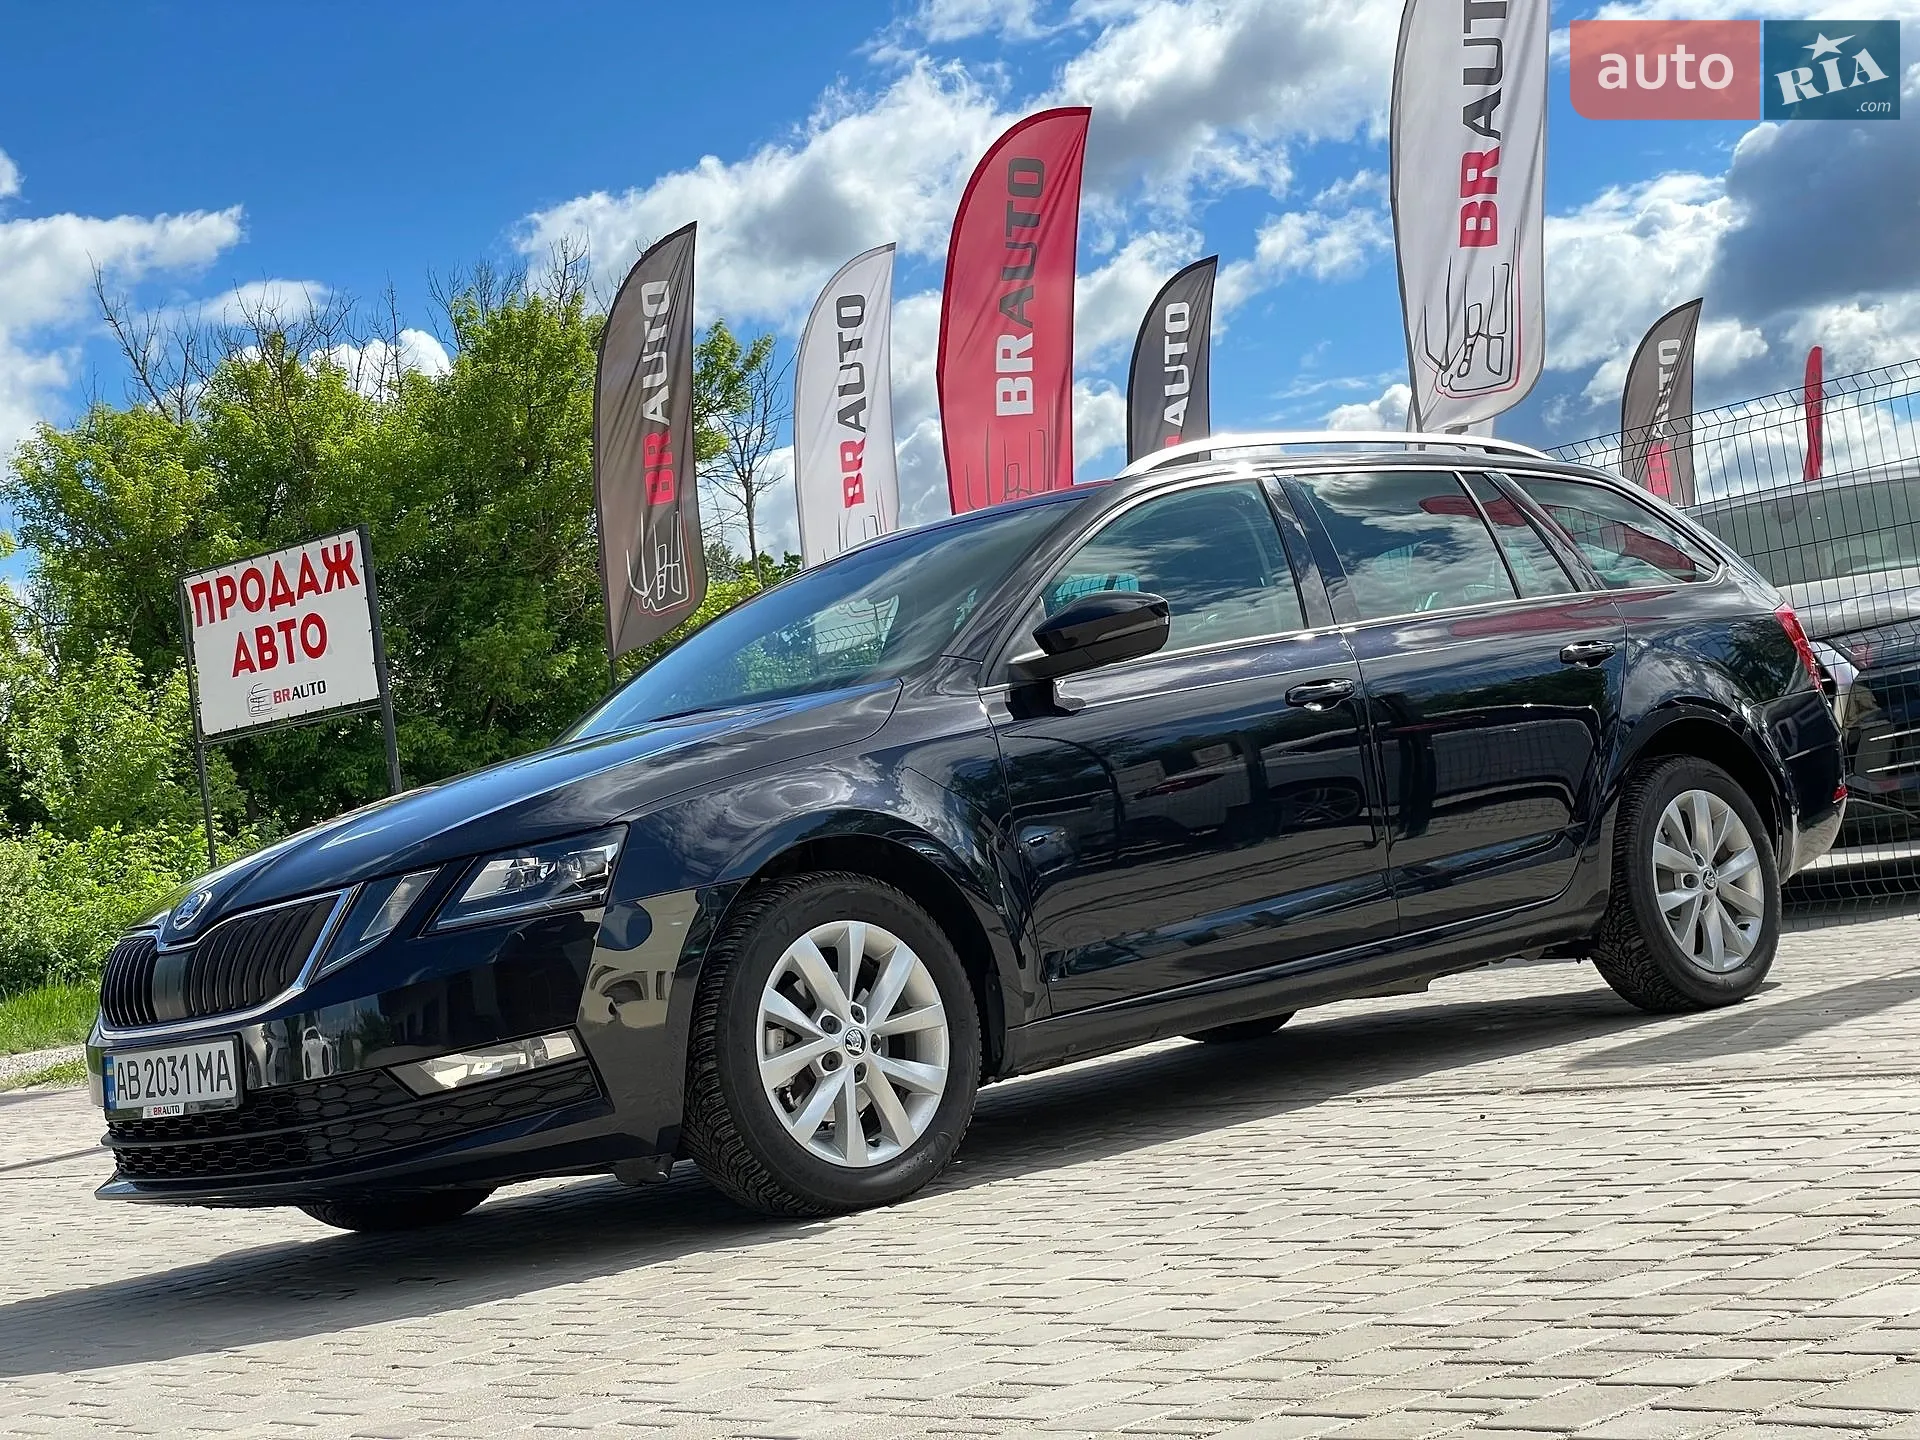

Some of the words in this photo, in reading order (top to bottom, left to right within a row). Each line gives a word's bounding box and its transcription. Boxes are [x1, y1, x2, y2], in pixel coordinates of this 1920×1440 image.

[995, 156, 1046, 417] BRAUTO
[640, 280, 676, 506] BRAUTO
[835, 293, 867, 509] BRAUTO
[190, 541, 360, 627] ПРОДАЖ
[231, 612, 328, 678] АВТО
[272, 679, 327, 705] BRAUTO
[117, 1059, 141, 1101] AB
[144, 1052, 191, 1098] 2031
[195, 1049, 233, 1094] MA
[153, 1105, 180, 1116] BRAUTO
